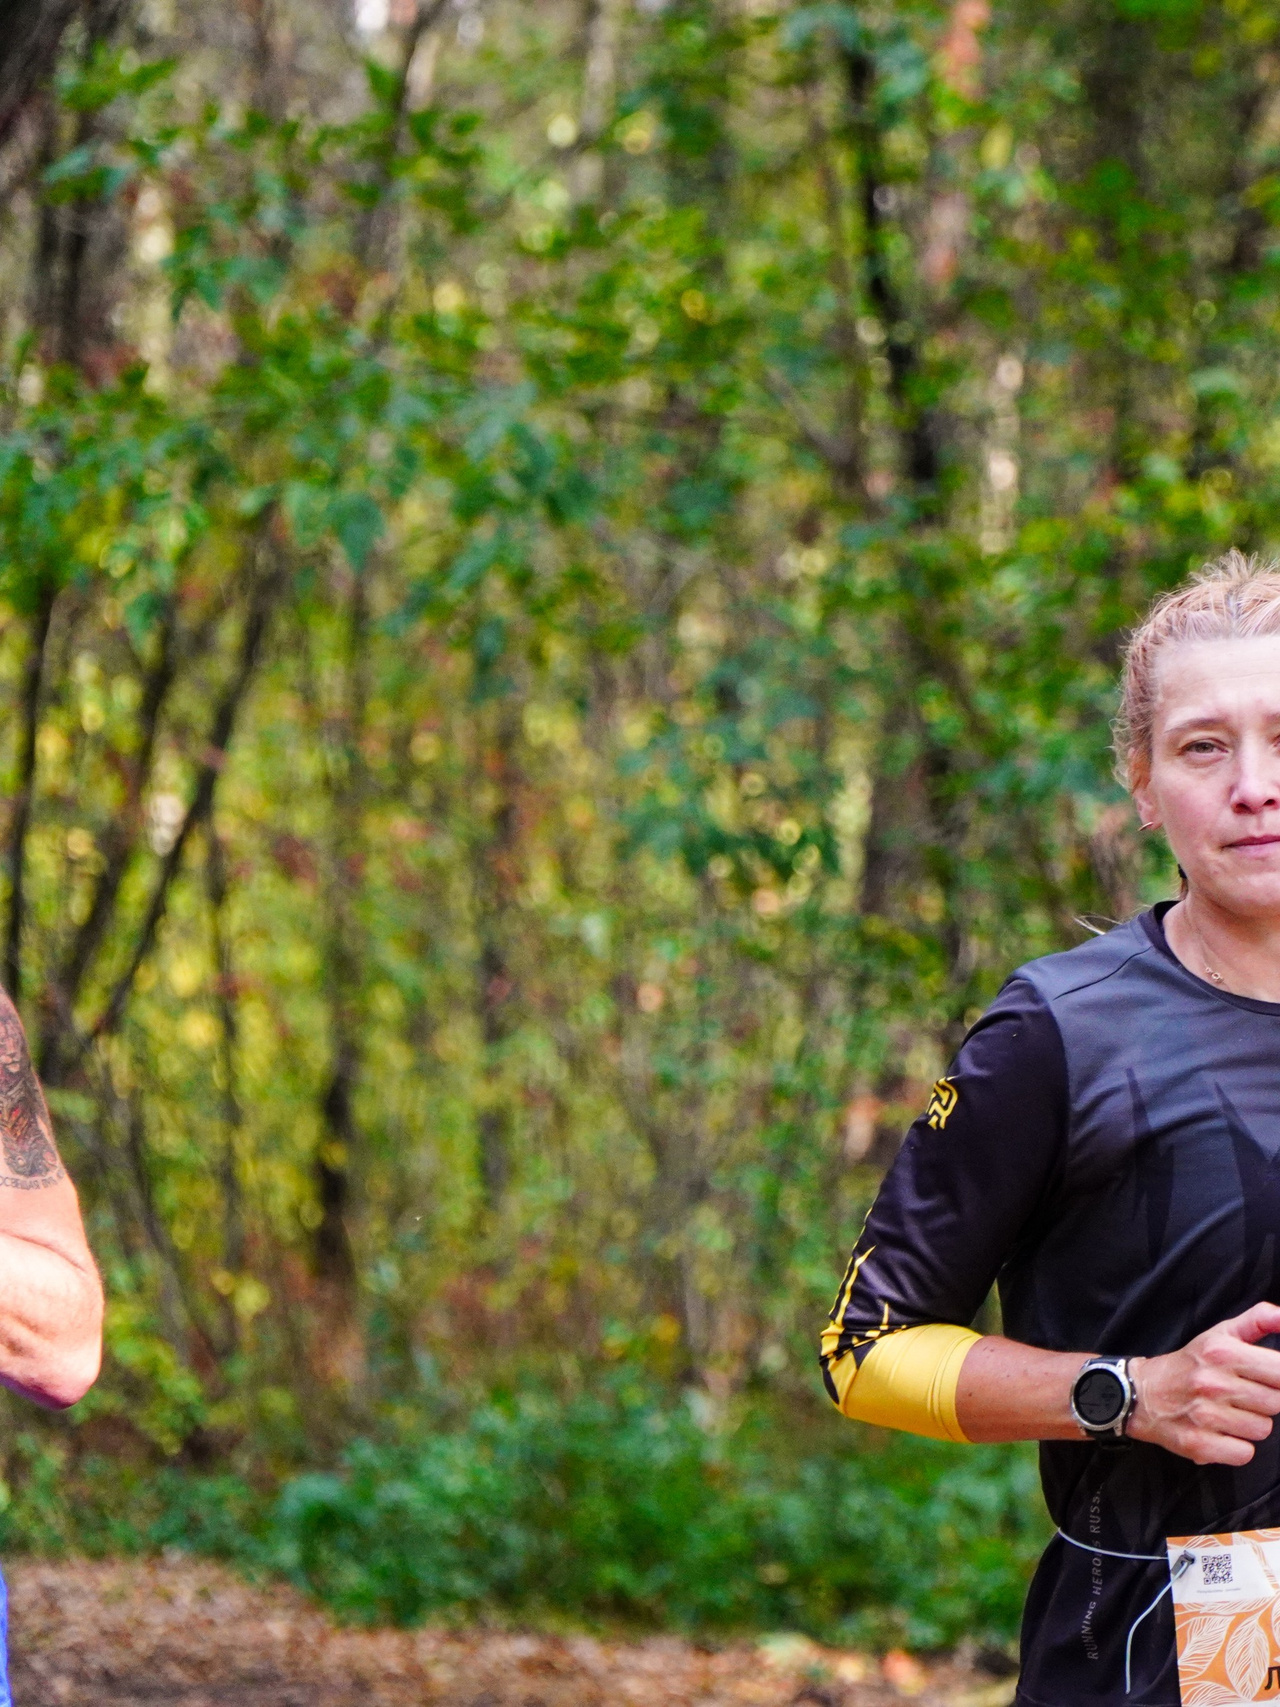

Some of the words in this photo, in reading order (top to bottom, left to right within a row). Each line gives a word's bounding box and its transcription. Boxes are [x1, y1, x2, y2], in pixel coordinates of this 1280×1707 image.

[1089, 1482, 1104, 1534] RUSS
[1092, 1539, 1103, 1595] HEROS
[1081, 1601, 1099, 1660] RUNNING
